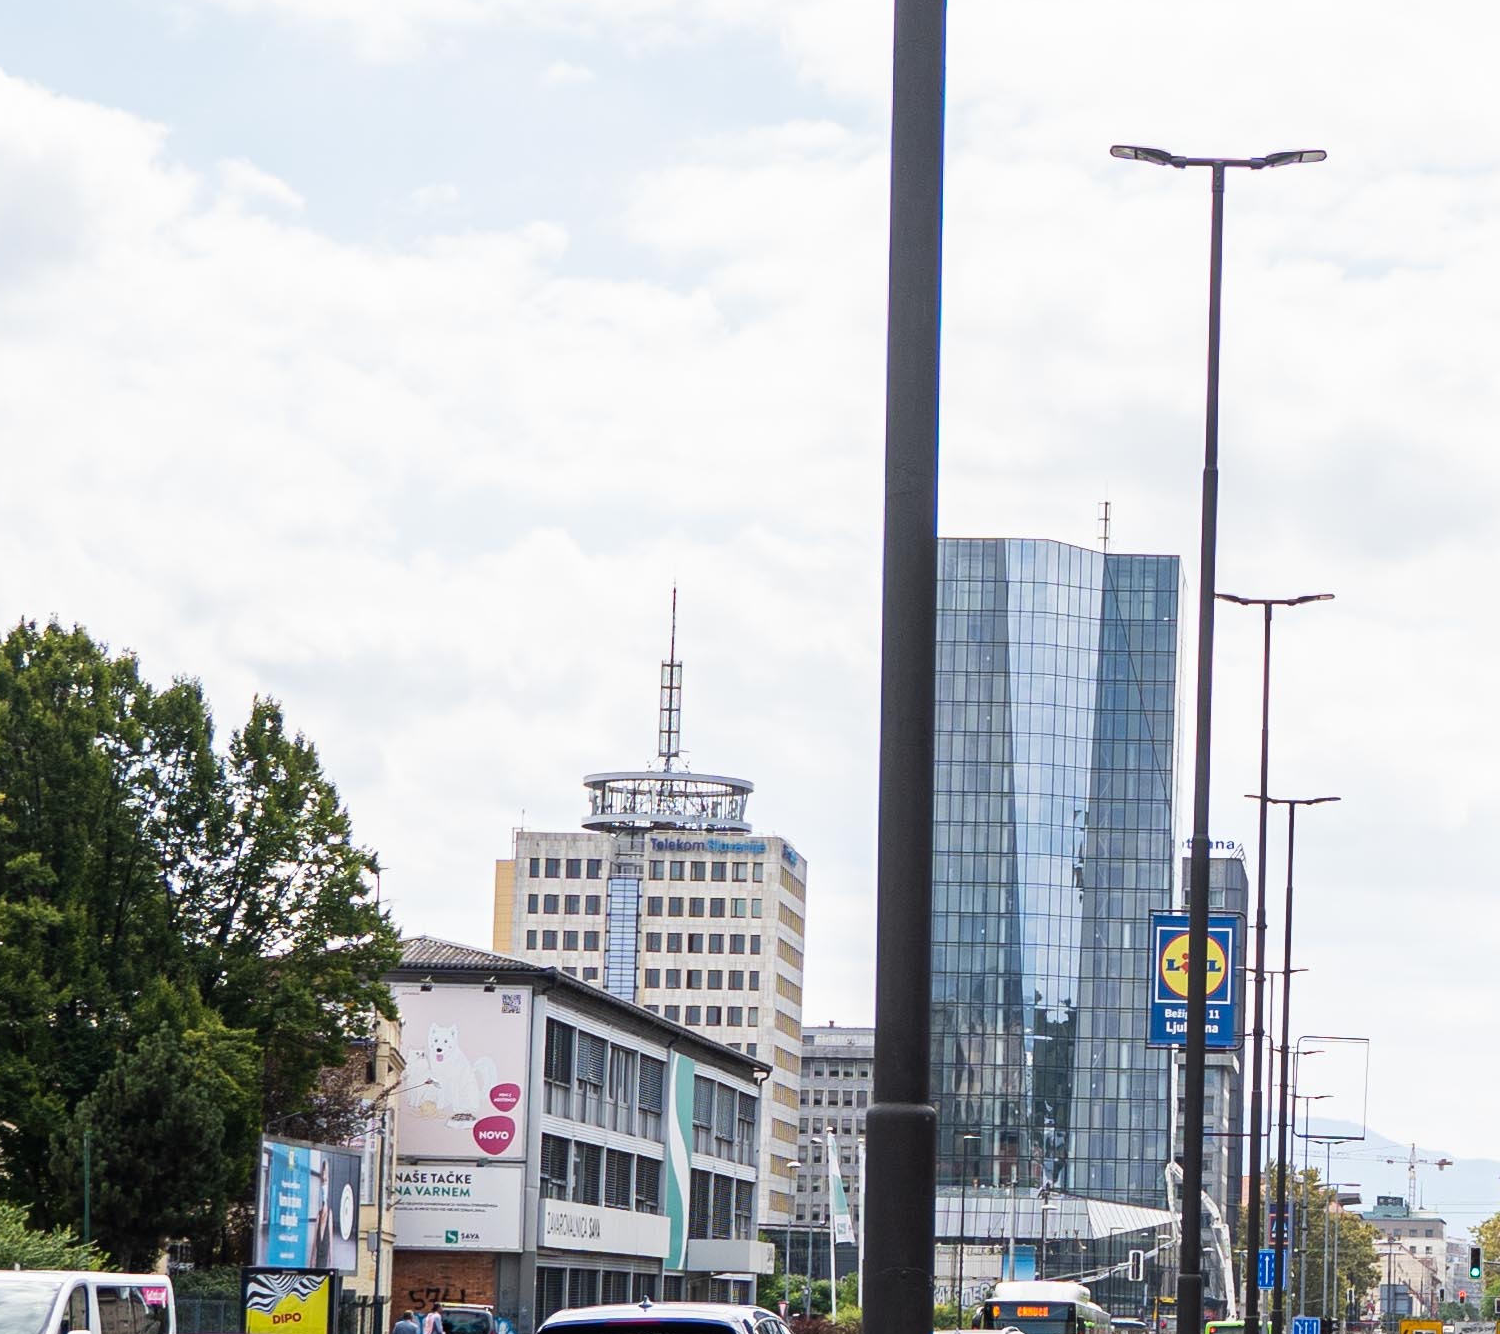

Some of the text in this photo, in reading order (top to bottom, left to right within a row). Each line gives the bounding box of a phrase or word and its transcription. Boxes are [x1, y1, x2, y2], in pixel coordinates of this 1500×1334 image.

[1166, 953, 1221, 973] LL
[1208, 1010, 1219, 1019] 11
[479, 1131, 509, 1139] NOVO
[396, 1170, 472, 1184] NAŠE TAČKE
[415, 1186, 471, 1197] VARNEM
[272, 1312, 302, 1324] DIPO
